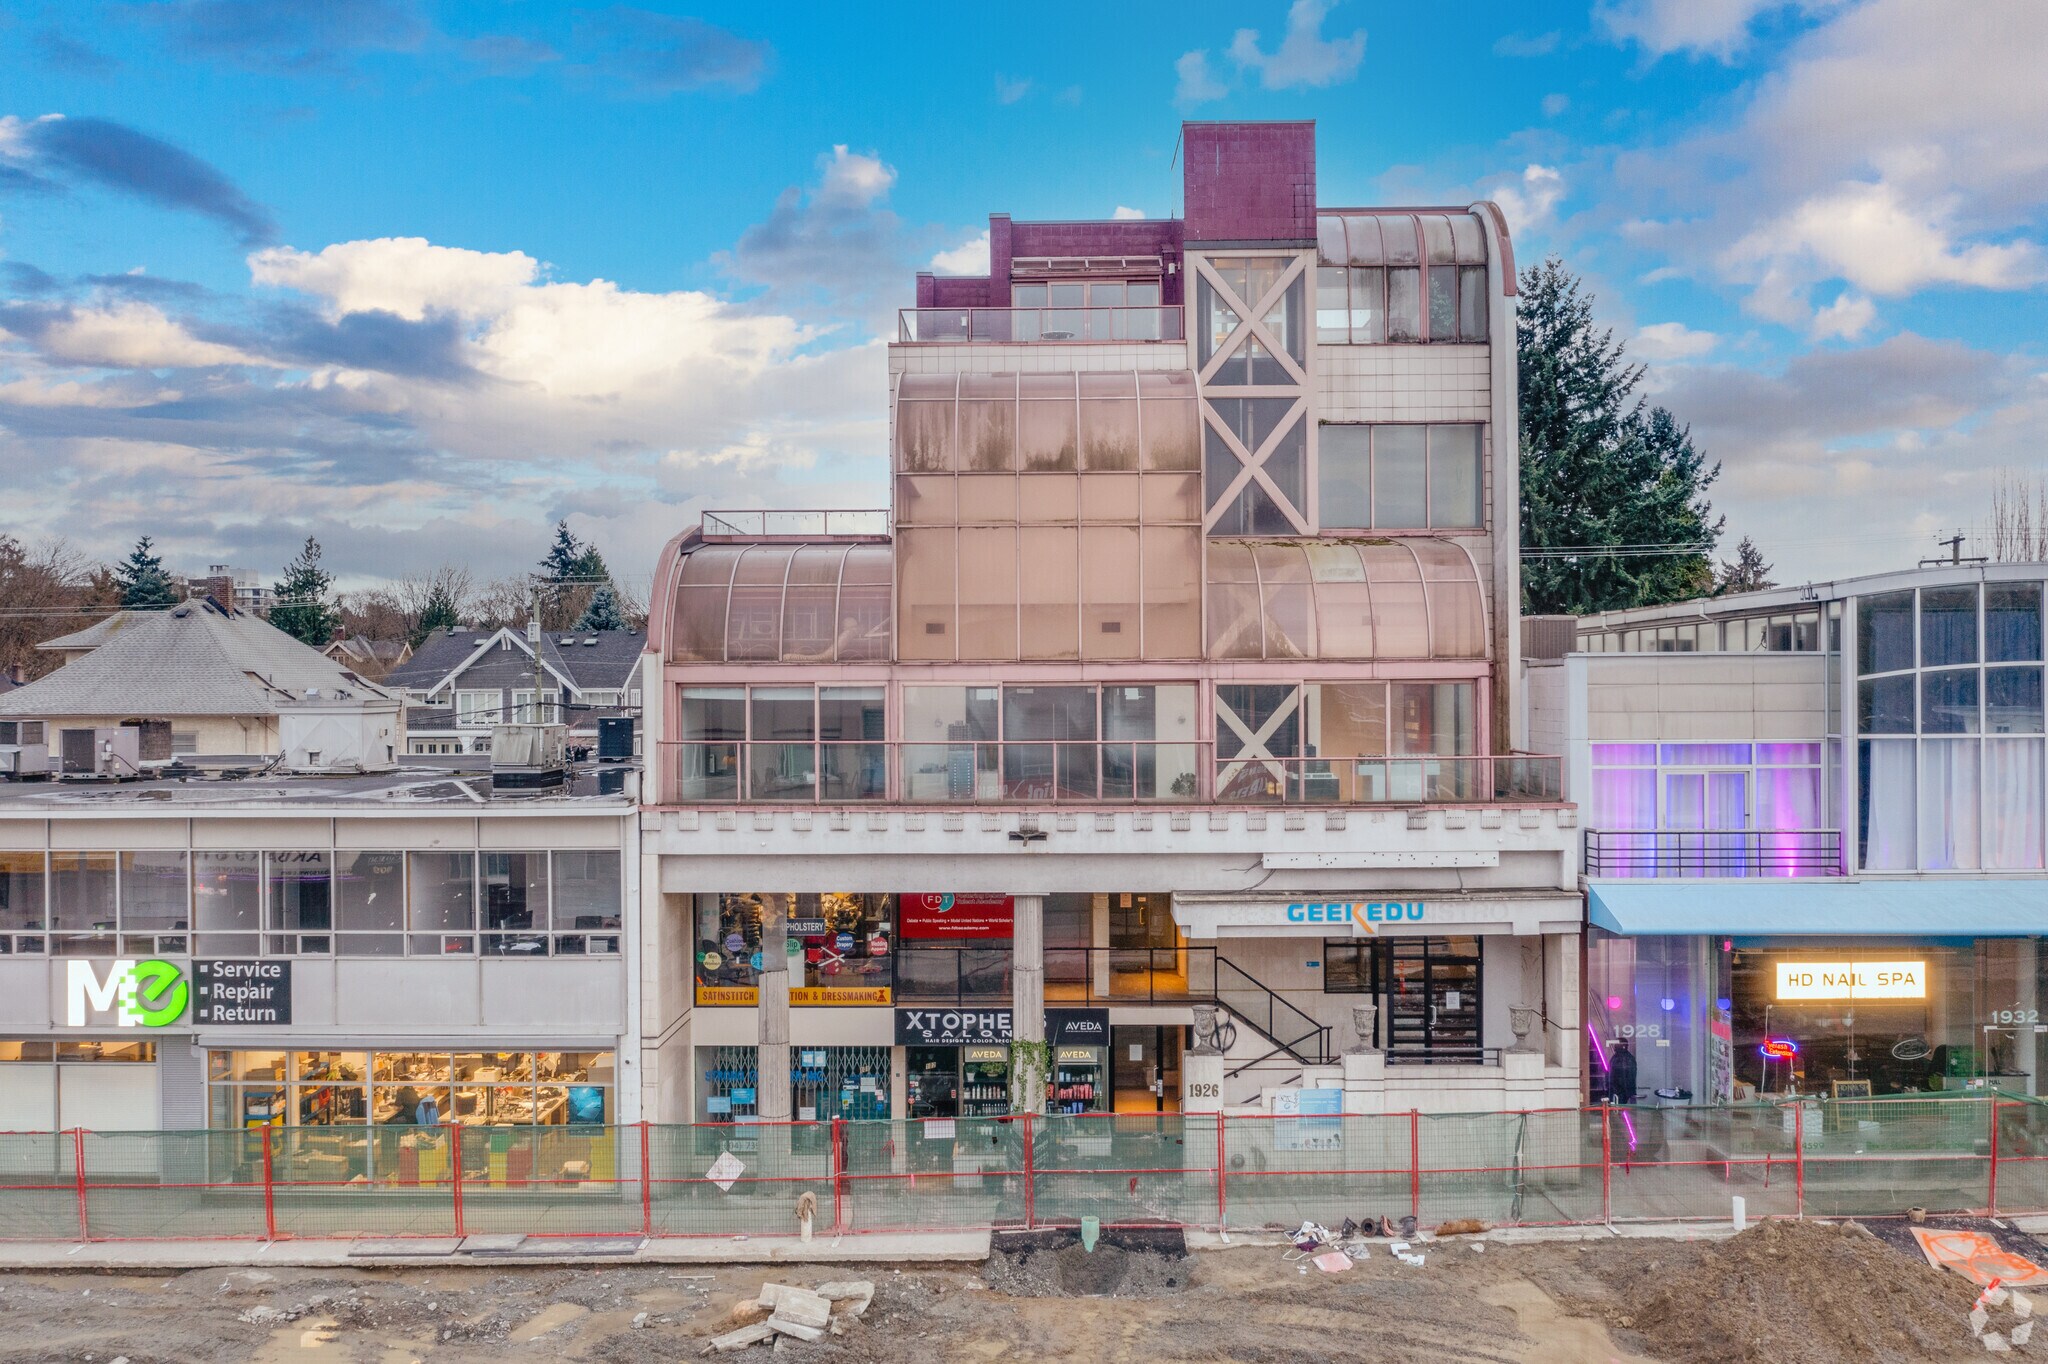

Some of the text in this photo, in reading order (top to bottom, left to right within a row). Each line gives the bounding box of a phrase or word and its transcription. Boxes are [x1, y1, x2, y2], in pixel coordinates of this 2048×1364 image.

[927, 895, 950, 904] FDT
[1288, 903, 1424, 934] GEEKEDU
[214, 962, 281, 977] Service
[1789, 972, 1915, 987] HD NAIL SPA
[214, 984, 274, 1002] Repair
[703, 991, 754, 1001] SATINSTITCH
[813, 991, 818, 1001] &
[822, 991, 878, 1001] DRESSMAKING
[214, 1006, 275, 1021] Return
[906, 1012, 1011, 1030] XTOPHE
[1991, 1009, 2039, 1025] 1932
[1065, 1021, 1102, 1031] AVEDA
[1613, 1024, 1661, 1039] 1928
[922, 1030, 1012, 1038] SALON
[971, 1051, 1002, 1059] AVEDA
[1060, 1051, 1091, 1059] AVEDA
[1189, 1083, 1219, 1098] 1926
